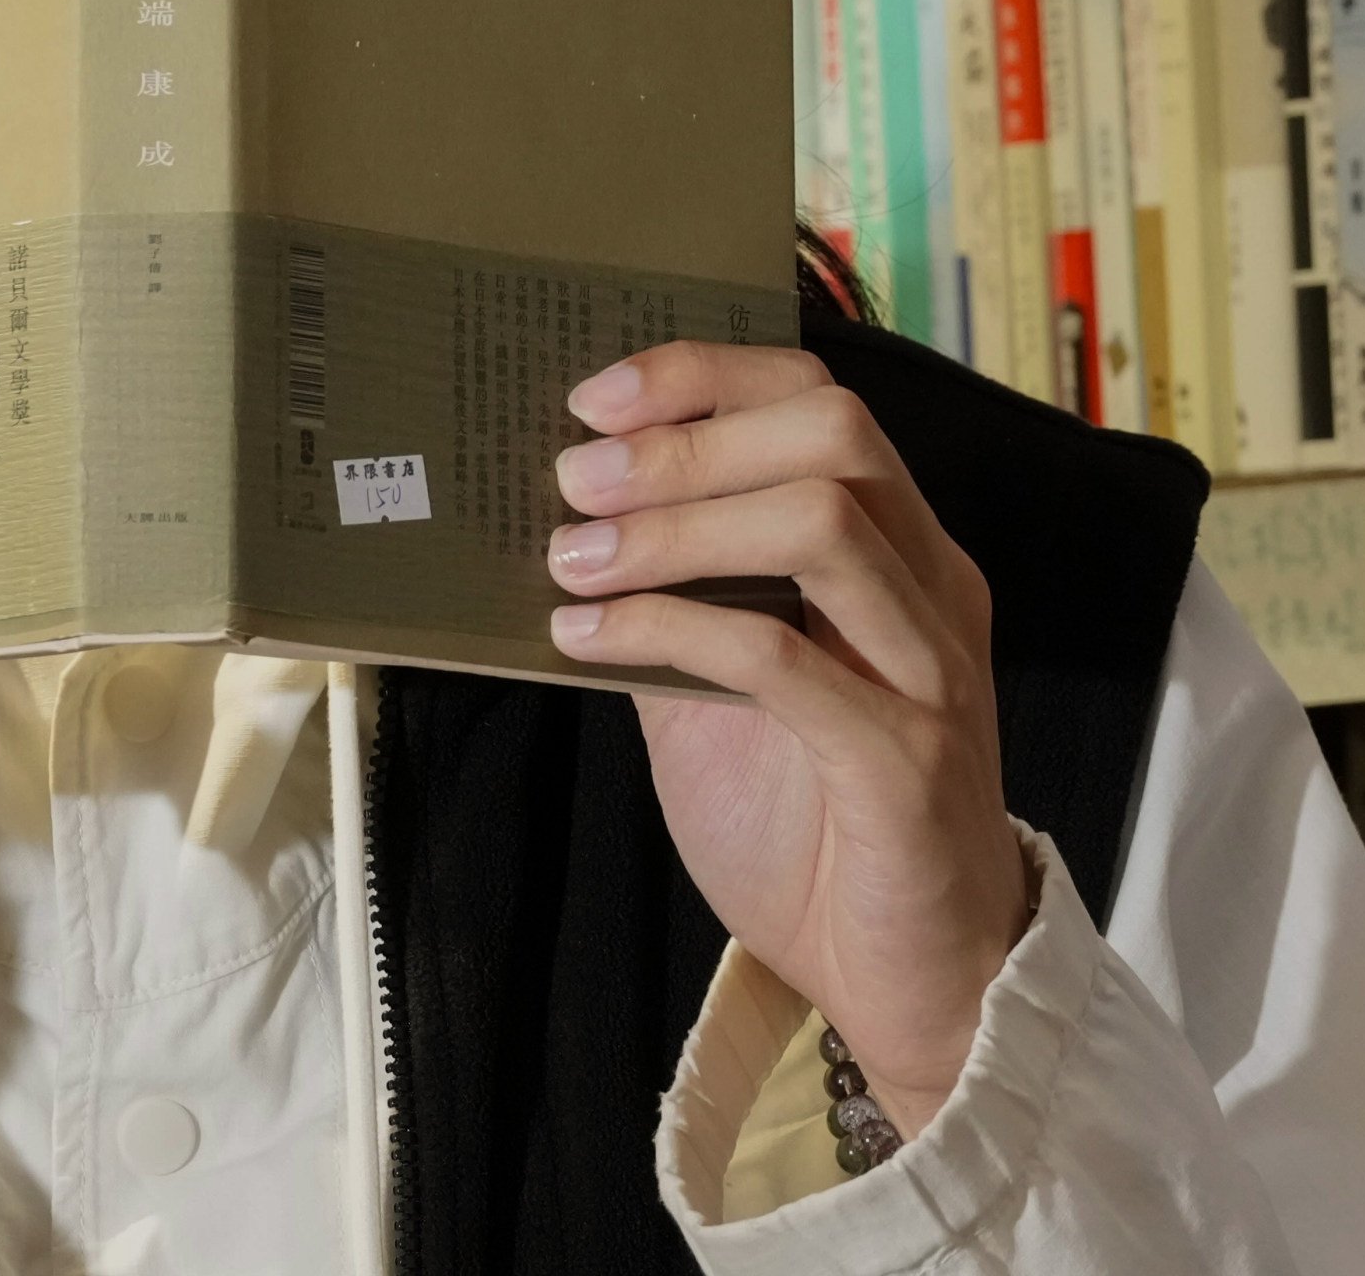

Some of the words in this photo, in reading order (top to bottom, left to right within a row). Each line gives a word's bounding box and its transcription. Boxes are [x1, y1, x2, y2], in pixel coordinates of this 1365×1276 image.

[8, 244, 31, 427] 諾貝爾文學獎
[344, 459, 416, 482] 界限書店
